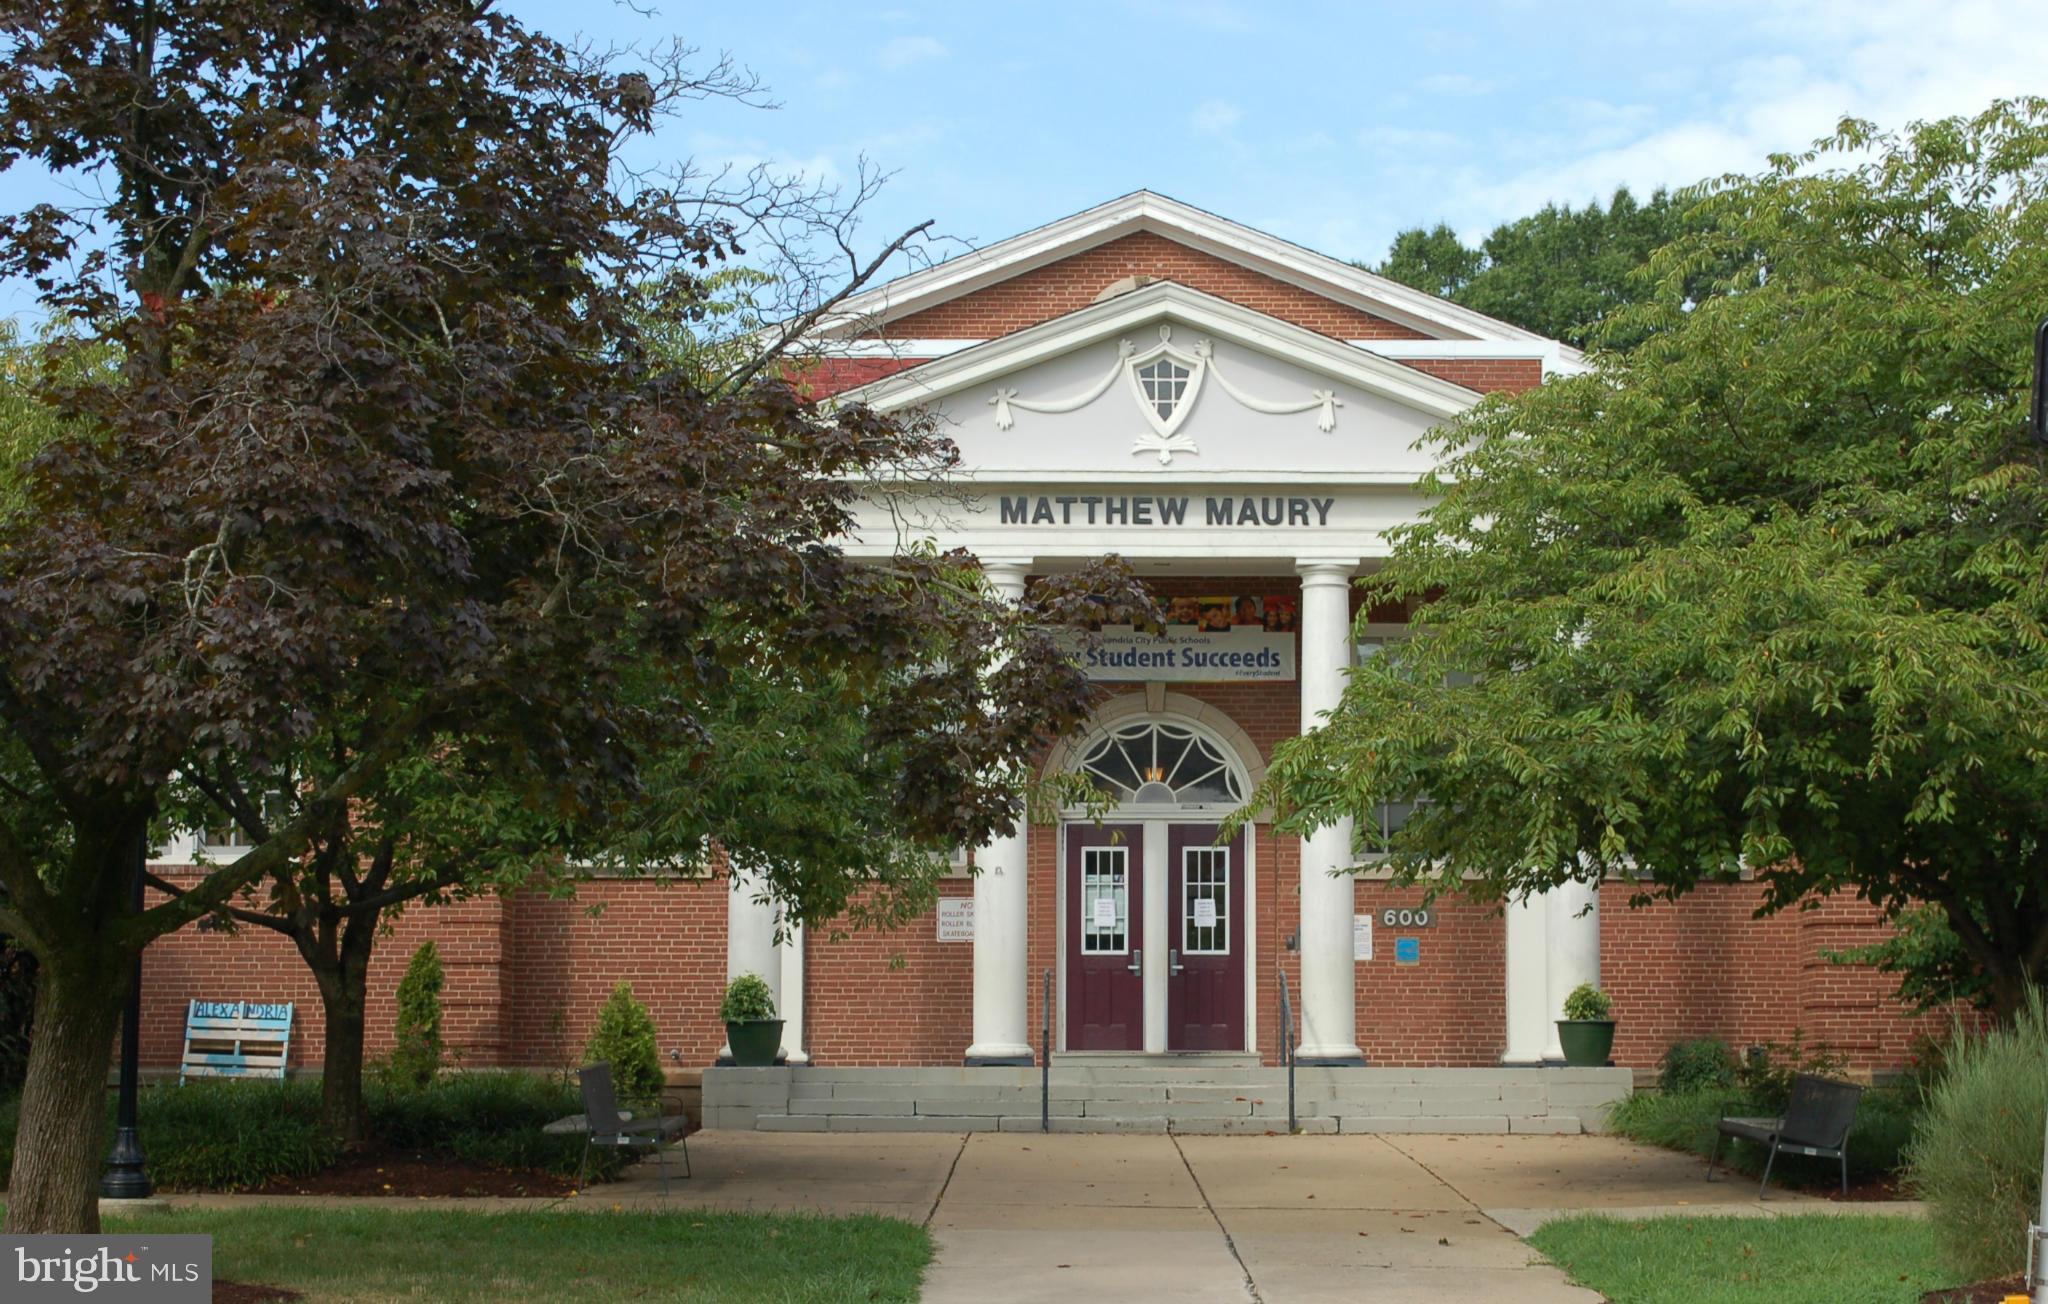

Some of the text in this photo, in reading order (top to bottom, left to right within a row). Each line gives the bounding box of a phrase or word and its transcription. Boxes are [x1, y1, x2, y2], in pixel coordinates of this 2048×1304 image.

[1000, 496, 1335, 526] MATTHEW MAURY
[1135, 635, 1151, 646] City
[1180, 635, 1210, 645] Schools
[1087, 647, 1176, 668] Student
[1182, 647, 1280, 668] Succeeds
[1384, 909, 1428, 926] 600
[195, 1002, 288, 1019] ALEXANDRIA
